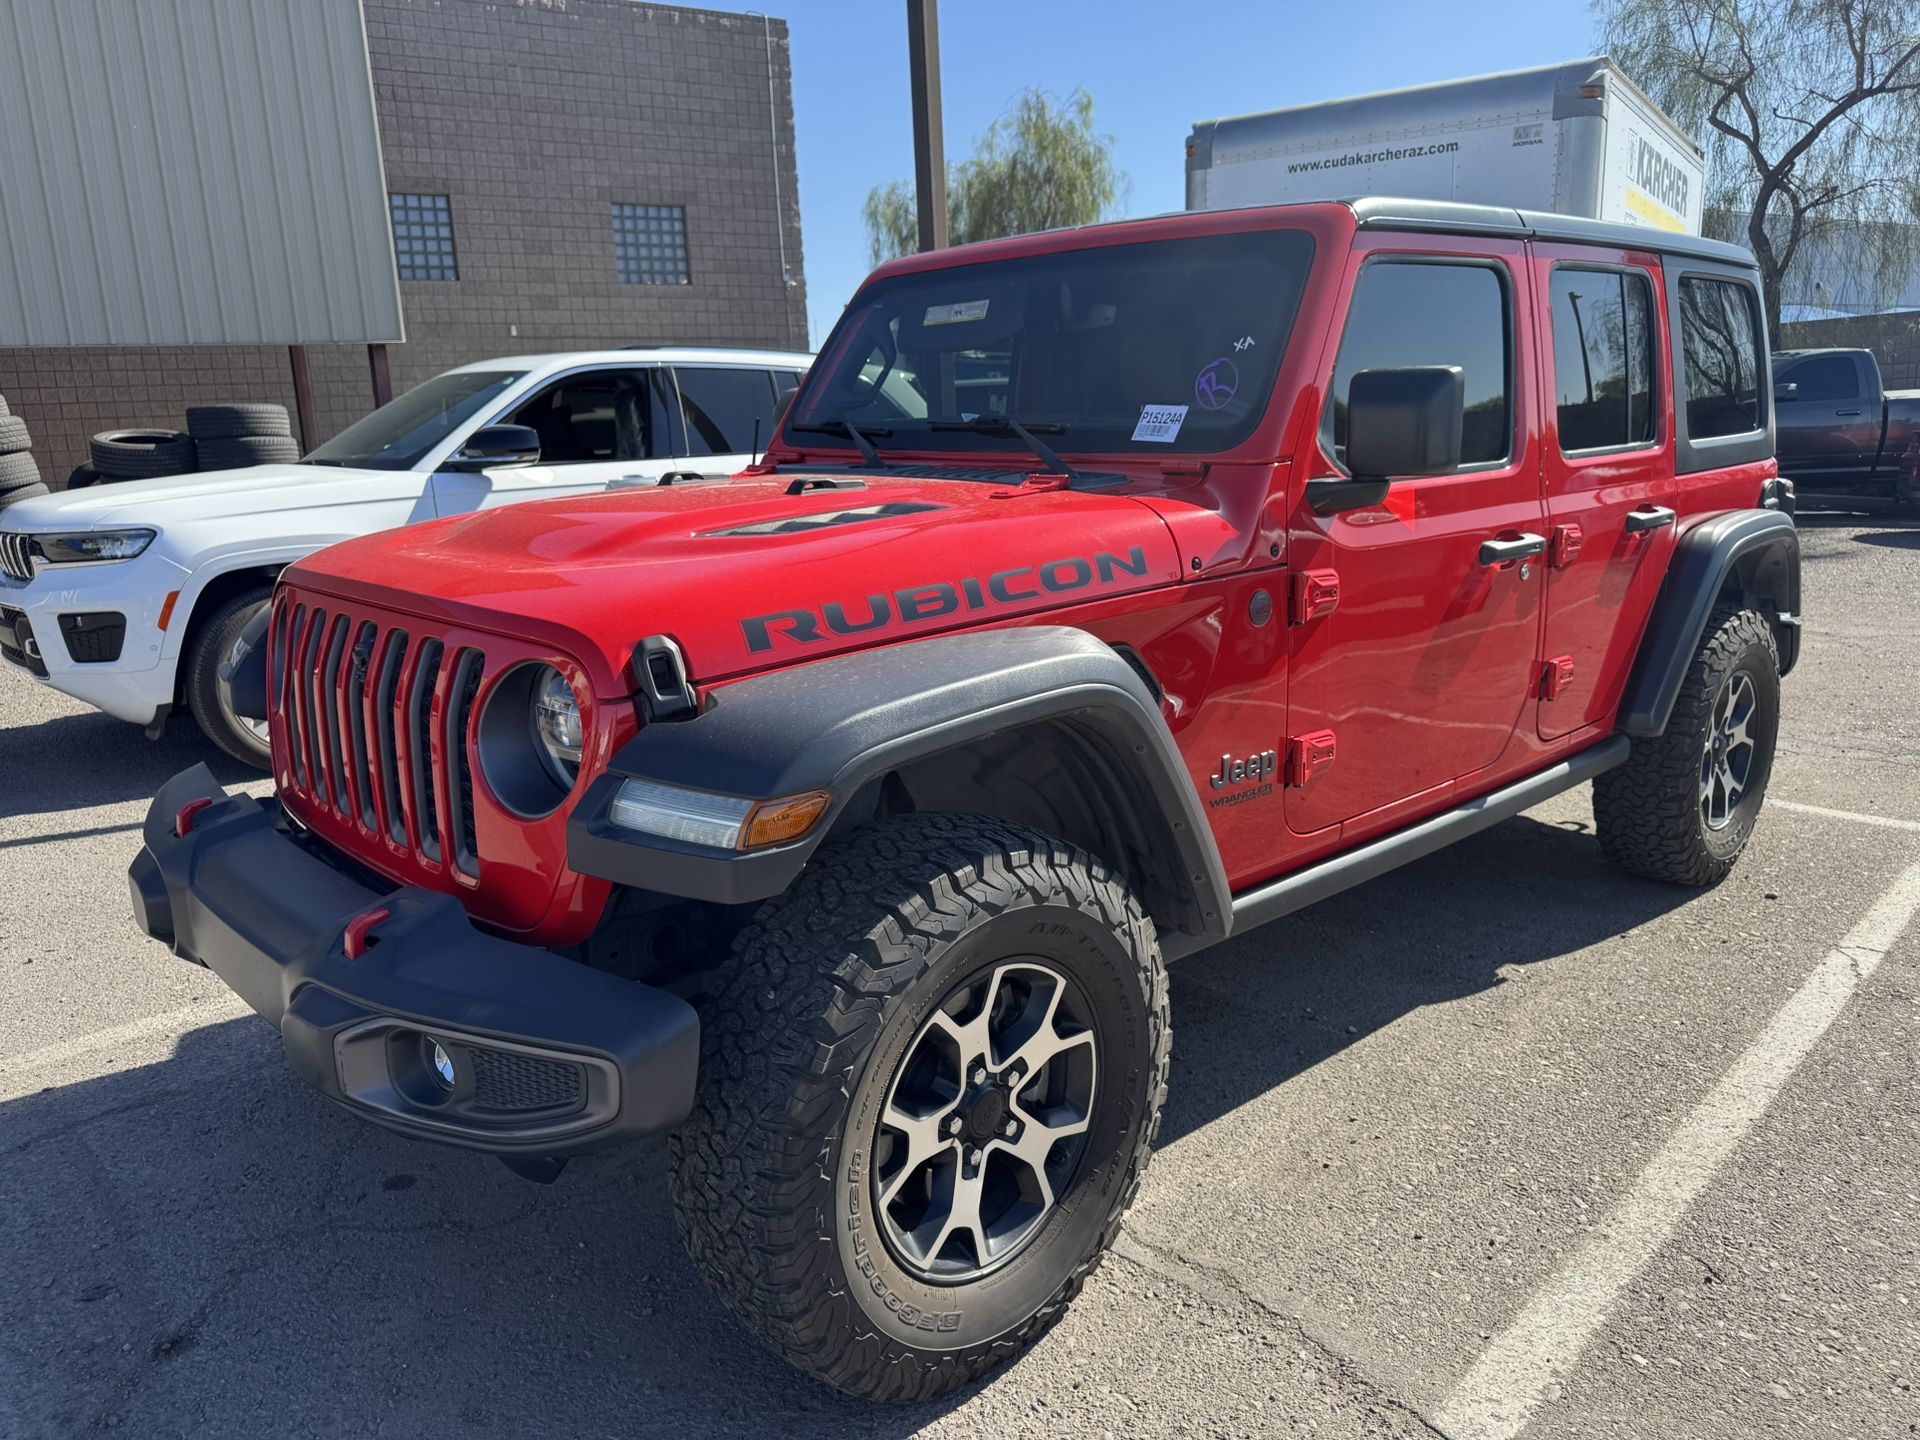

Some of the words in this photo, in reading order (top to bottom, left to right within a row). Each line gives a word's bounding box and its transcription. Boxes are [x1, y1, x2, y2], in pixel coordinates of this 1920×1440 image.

[1287, 141, 1459, 173] www.cudakarcheraz.com
[1140, 411, 1182, 425] P15124A
[740, 546, 1150, 655] RUBICON
[1210, 749, 1277, 791] Jeep
[1209, 783, 1273, 809] WRANGLER
